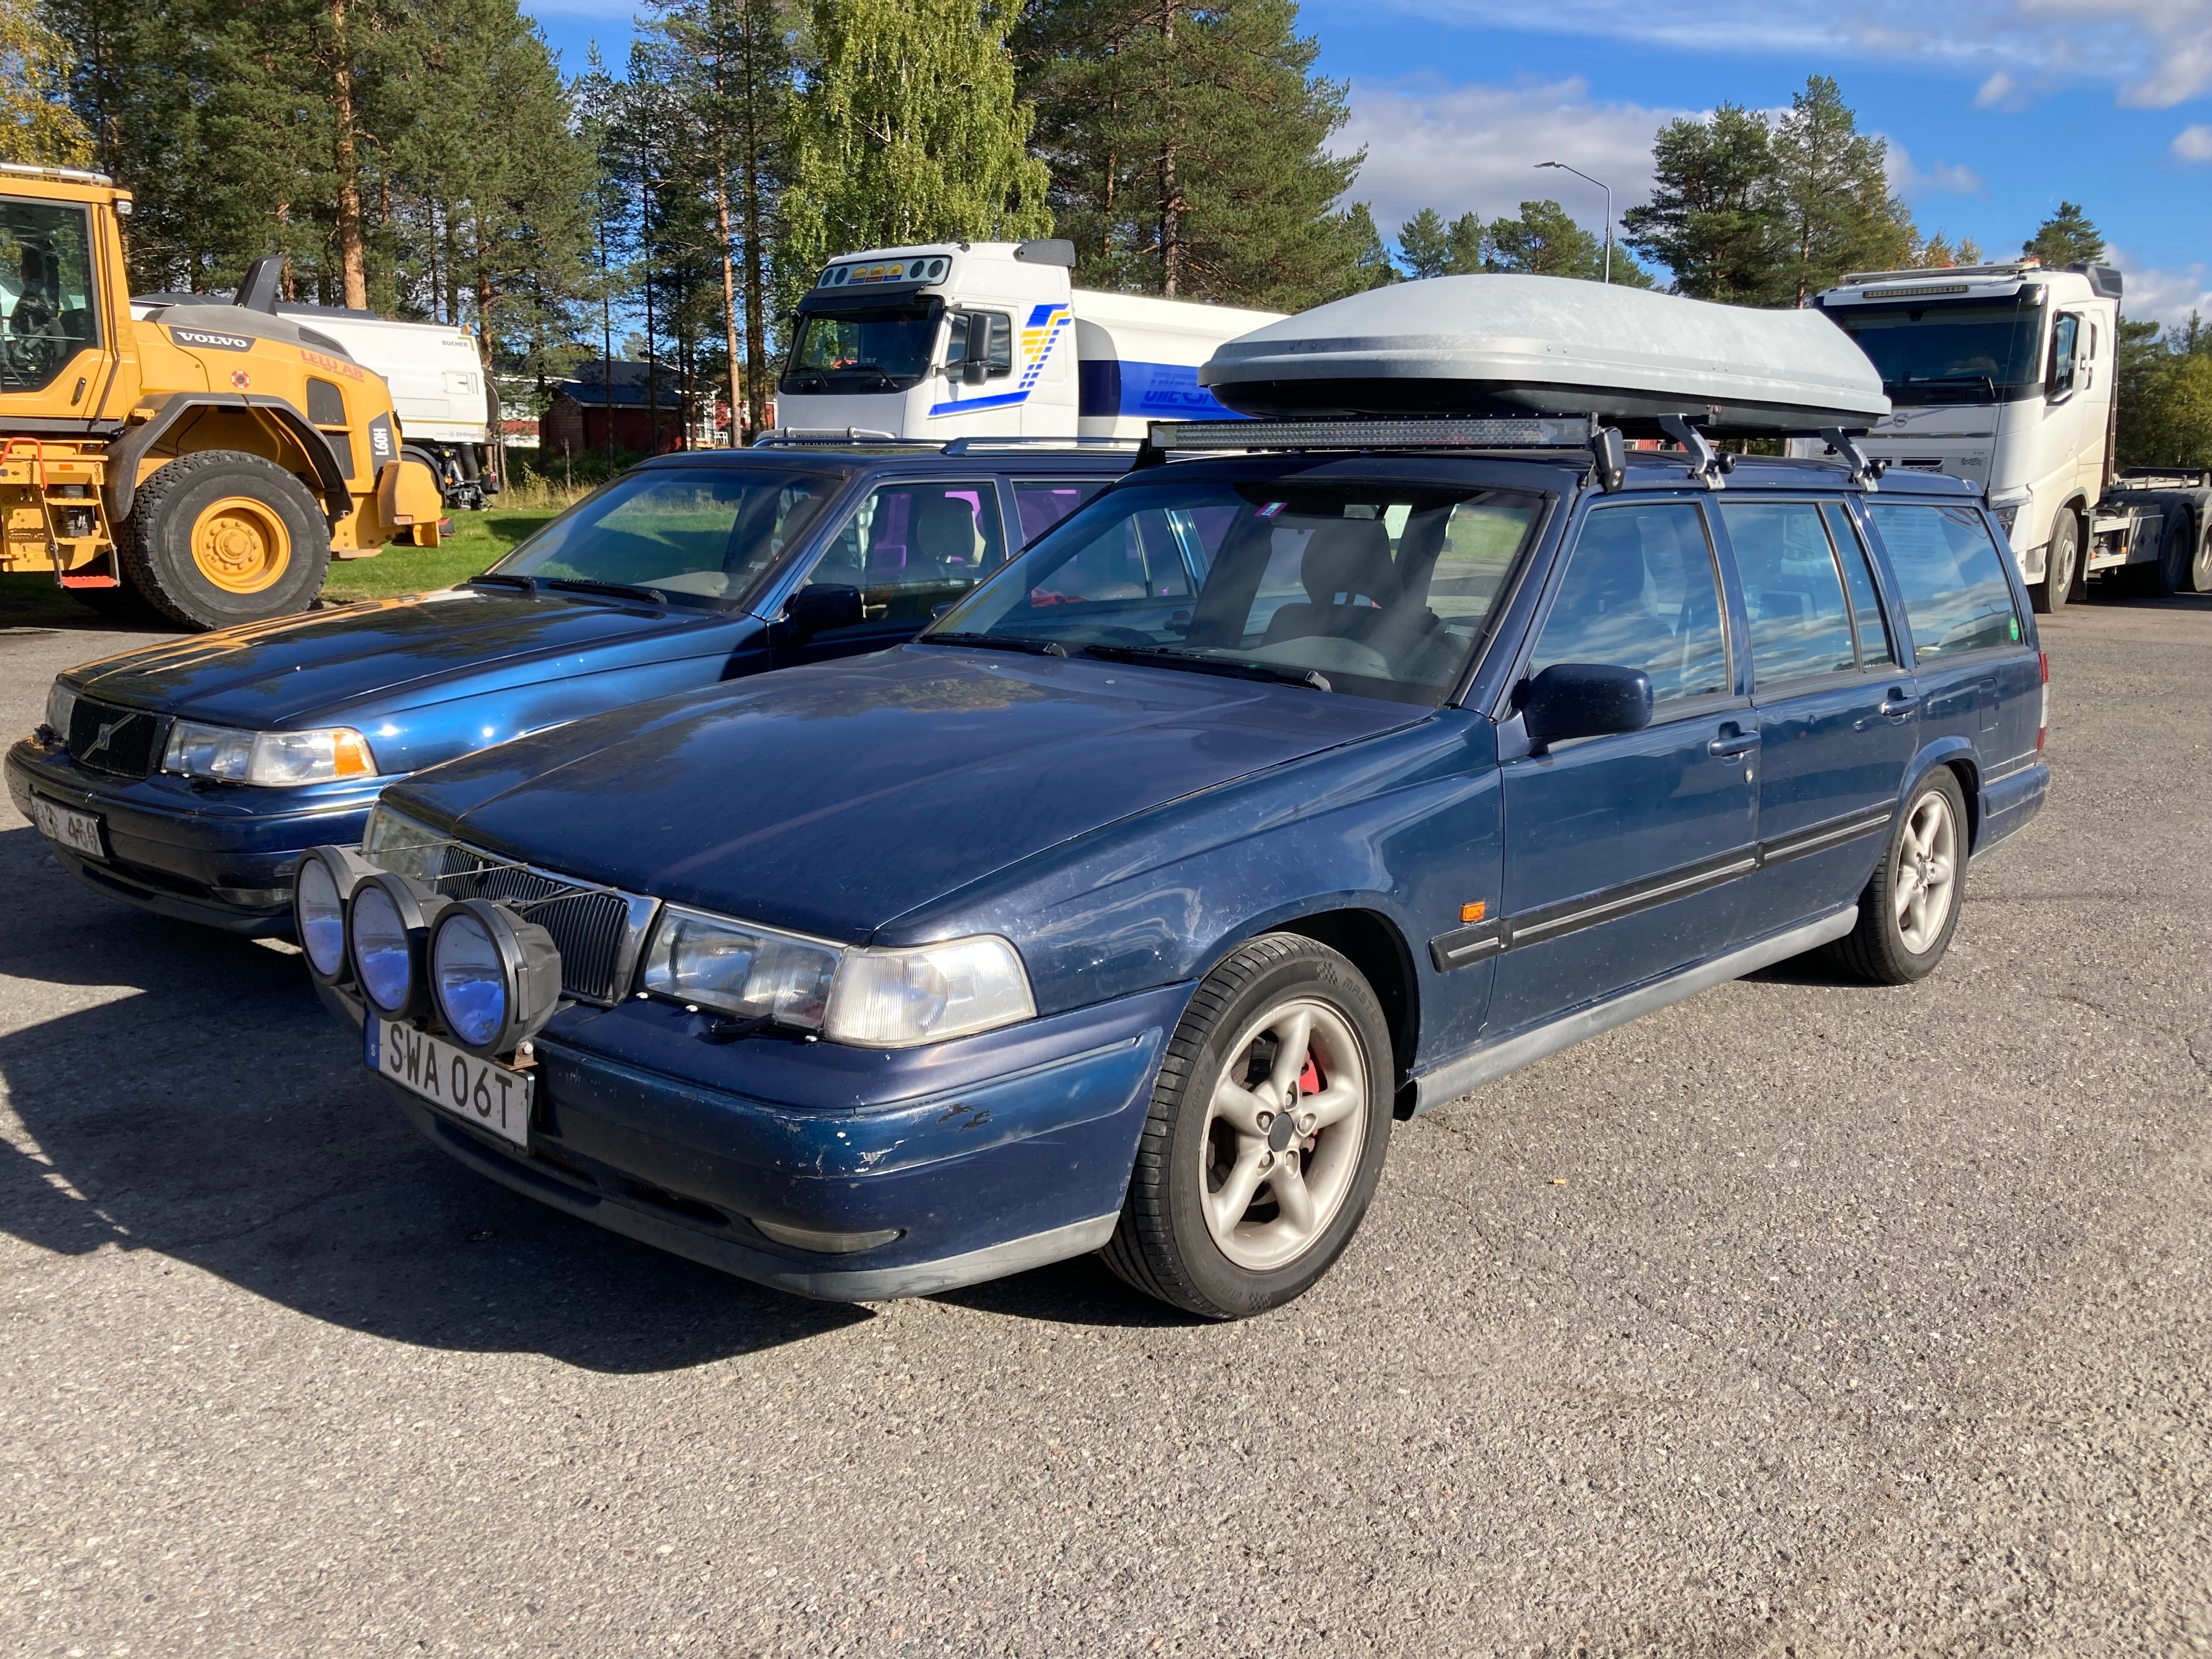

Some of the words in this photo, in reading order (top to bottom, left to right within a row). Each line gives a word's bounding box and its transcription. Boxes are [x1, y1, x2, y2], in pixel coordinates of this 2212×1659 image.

[177, 332, 247, 347] VOLVO
[300, 349, 338, 370] LELU
[342, 363, 363, 379] AB
[373, 428, 390, 455] L60H
[370, 1044, 376, 1057] S
[390, 1023, 439, 1096] SWA
[452, 1056, 512, 1129] 06T
